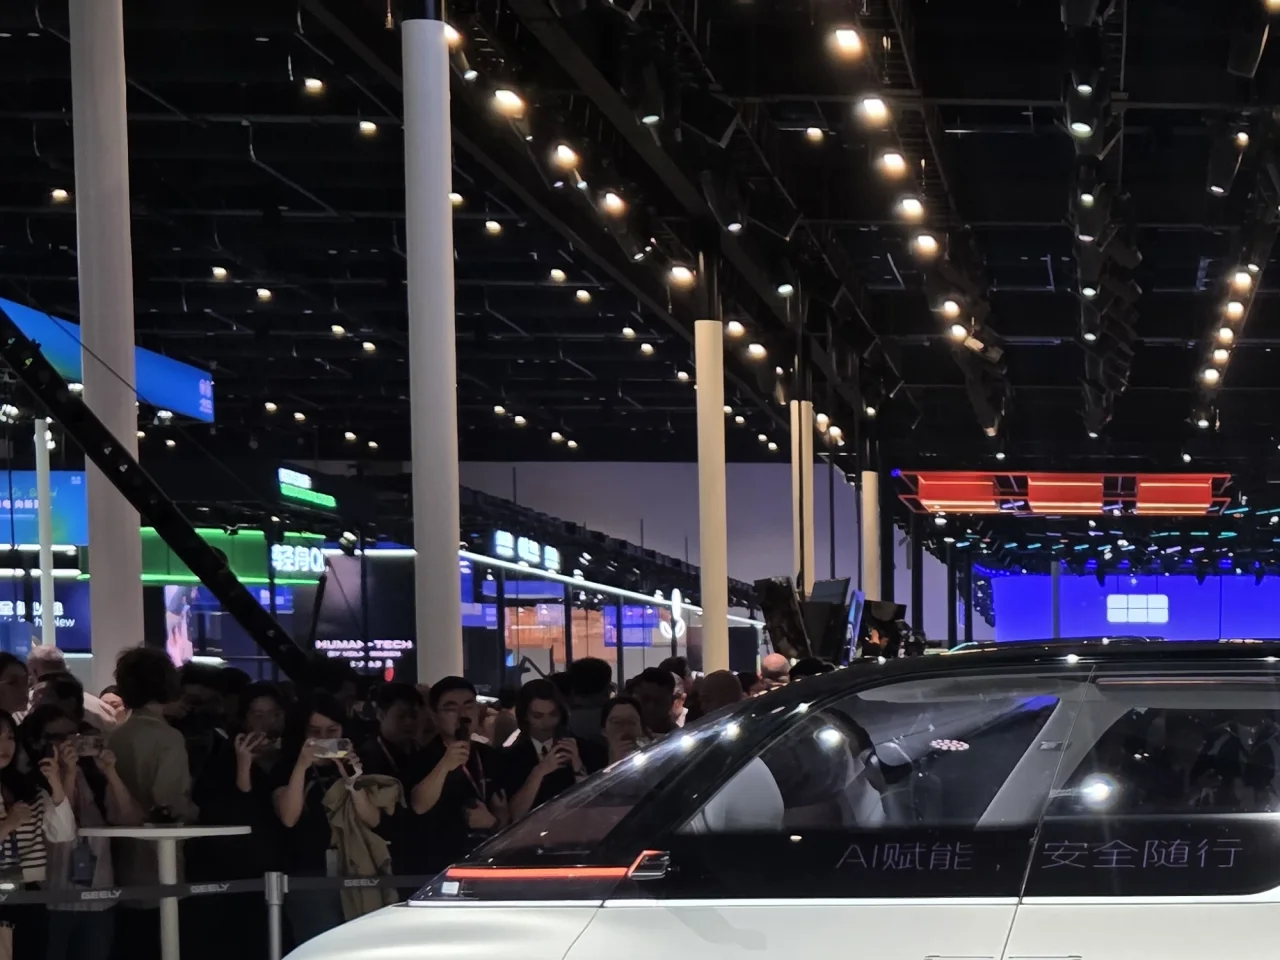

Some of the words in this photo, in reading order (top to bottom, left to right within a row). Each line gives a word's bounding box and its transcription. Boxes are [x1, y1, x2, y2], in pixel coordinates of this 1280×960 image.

[1041, 838, 1244, 870] 安全随行
[344, 878, 380, 887] GEELY
[190, 883, 230, 894] GEELY
[81, 889, 122, 900] GEELY
